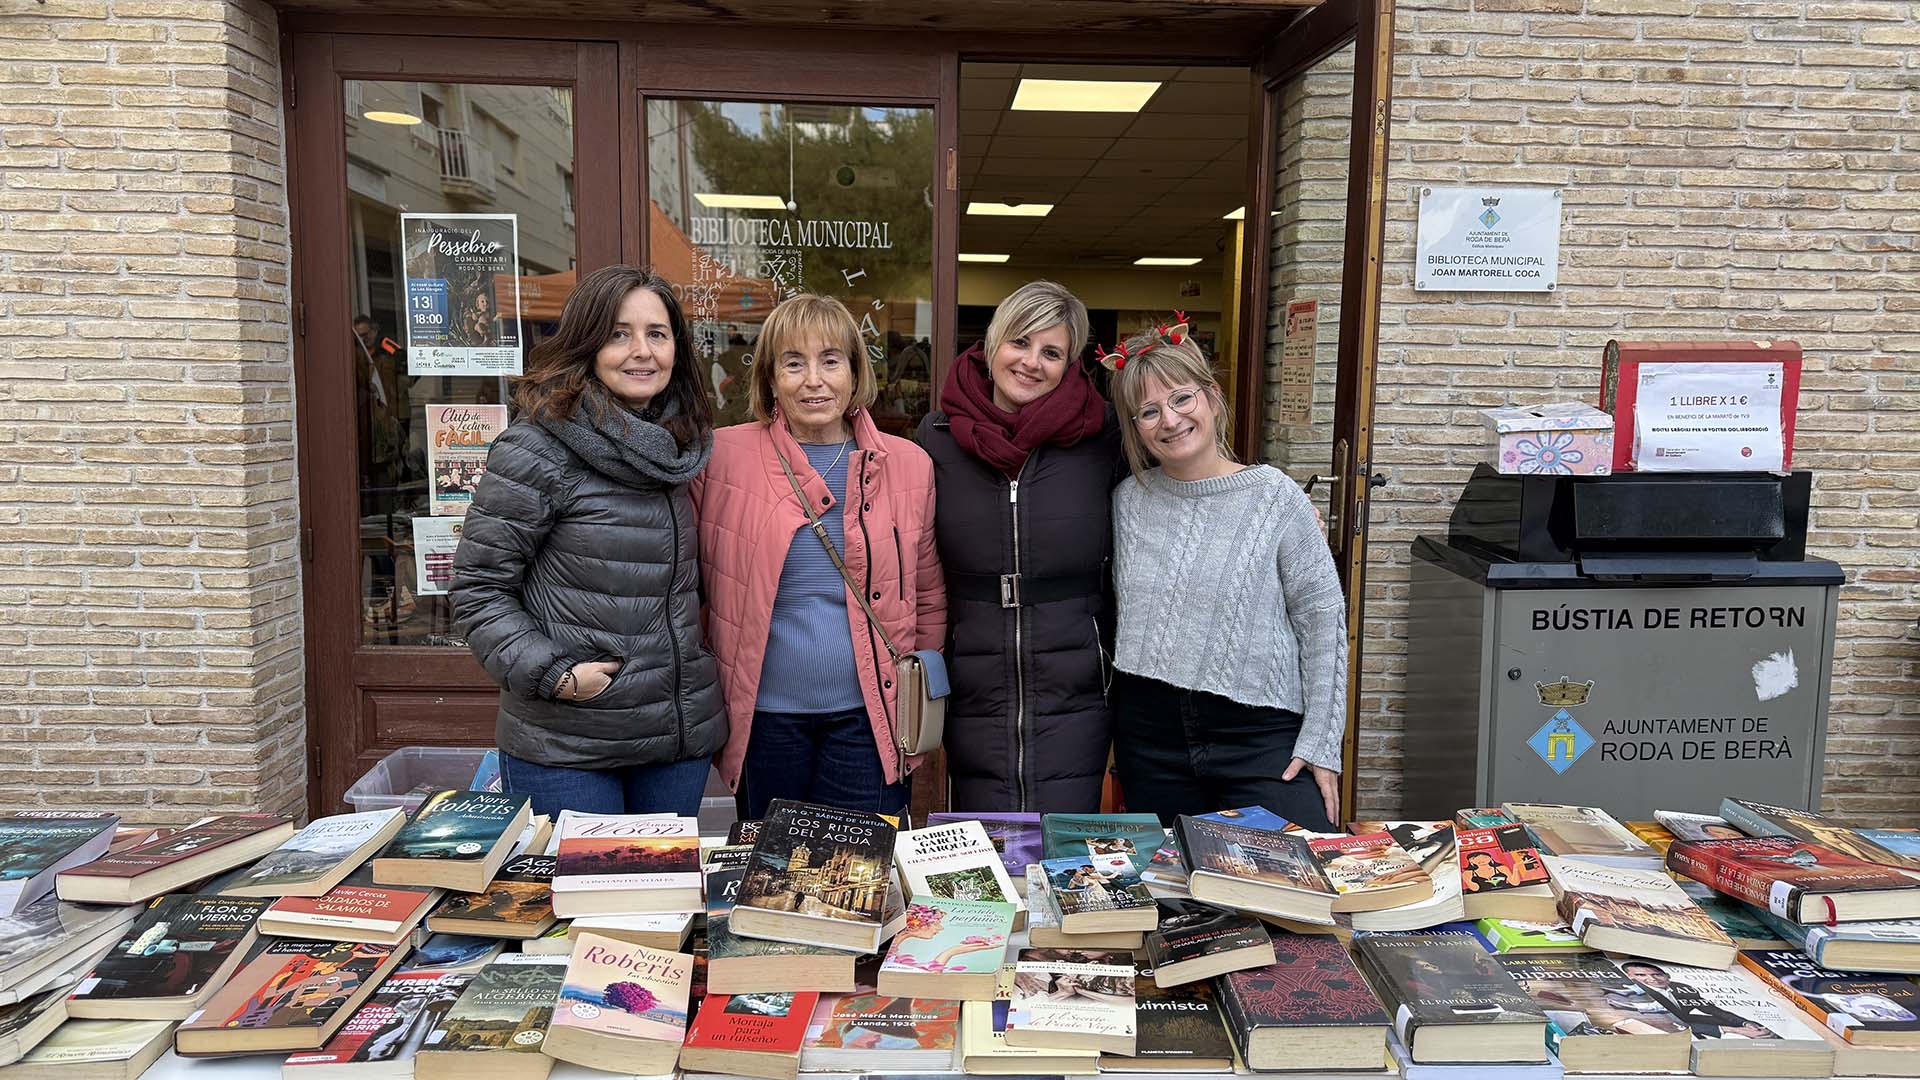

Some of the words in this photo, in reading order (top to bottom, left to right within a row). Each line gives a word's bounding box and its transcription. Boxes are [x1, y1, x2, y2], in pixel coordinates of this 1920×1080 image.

[690, 217, 793, 247] BIBLIOTECA
[796, 220, 893, 249] MUNICIPAL
[427, 229, 497, 256] Pessebre
[1428, 255, 1489, 265] BIBLIOTECA
[1490, 256, 1545, 266] MUNICIPAL
[1431, 268, 1456, 277] JOAN
[1458, 269, 1513, 278] MARTORELL
[1515, 270, 1541, 278] COCA
[412, 295, 430, 309] 13
[413, 313, 443, 324] 18:00
[1670, 396, 1677, 406] 1
[1680, 396, 1717, 406] LLIBRE
[1719, 395, 1727, 405] X
[1730, 396, 1737, 405] 1
[1739, 395, 1748, 406] €
[441, 407, 471, 424] Club
[457, 420, 492, 432] Lectura
[435, 424, 486, 448] FÀCIL
[1532, 604, 1634, 631] BÚSTIA
[1643, 608, 1680, 629] DE
[1690, 606, 1806, 629] RETORN
[1603, 718, 1736, 735] AJUNTAMENT
[1741, 717, 1769, 733] DE
[1600, 741, 1674, 762] RODA
[1682, 741, 1716, 760] DE
[1724, 736, 1793, 760] BERÀ
[473, 794, 510, 805] Nora
[433, 798, 515, 815] Roberts
[815, 812, 844, 821] SÁENZ
[791, 817, 820, 829] LOS
[829, 823, 873, 836] RITOS
[789, 826, 815, 838] DEL
[822, 832, 871, 846] AGUA
[912, 828, 969, 842] GABRIEL
[1340, 836, 1394, 850] Andersen
[515, 857, 556, 867] AGA
[507, 864, 556, 874] CHRI
[332, 888, 356, 896] Javier
[358, 890, 388, 899] Cercas
[312, 895, 375, 906] SOLDADOS
[375, 900, 392, 908] DE
[201, 905, 239, 913] FLOR
[314, 903, 373, 915] SALAMINA
[634, 948, 674, 965] Nora
[584, 946, 684, 980] Roberts
[1507, 969, 1622, 981] hipnotista
[1684, 973, 1745, 983] OBAMA
[385, 978, 467, 987] WRENCE
[376, 986, 438, 994] BLOCK
[1676, 986, 1751, 995] AUDACIA
[473, 992, 560, 1000] ALGEBRIST
[1135, 1000, 1209, 1011] uimista
[1679, 999, 1778, 1008] ESPERANZA
[833, 1011, 857, 1019] José
[859, 1011, 887, 1019] María
[889, 1012, 939, 1020] Mendiluce
[728, 1016, 775, 1030] Mortaja
[851, 1020, 890, 1028] Luanda,
[734, 1026, 762, 1037] para
